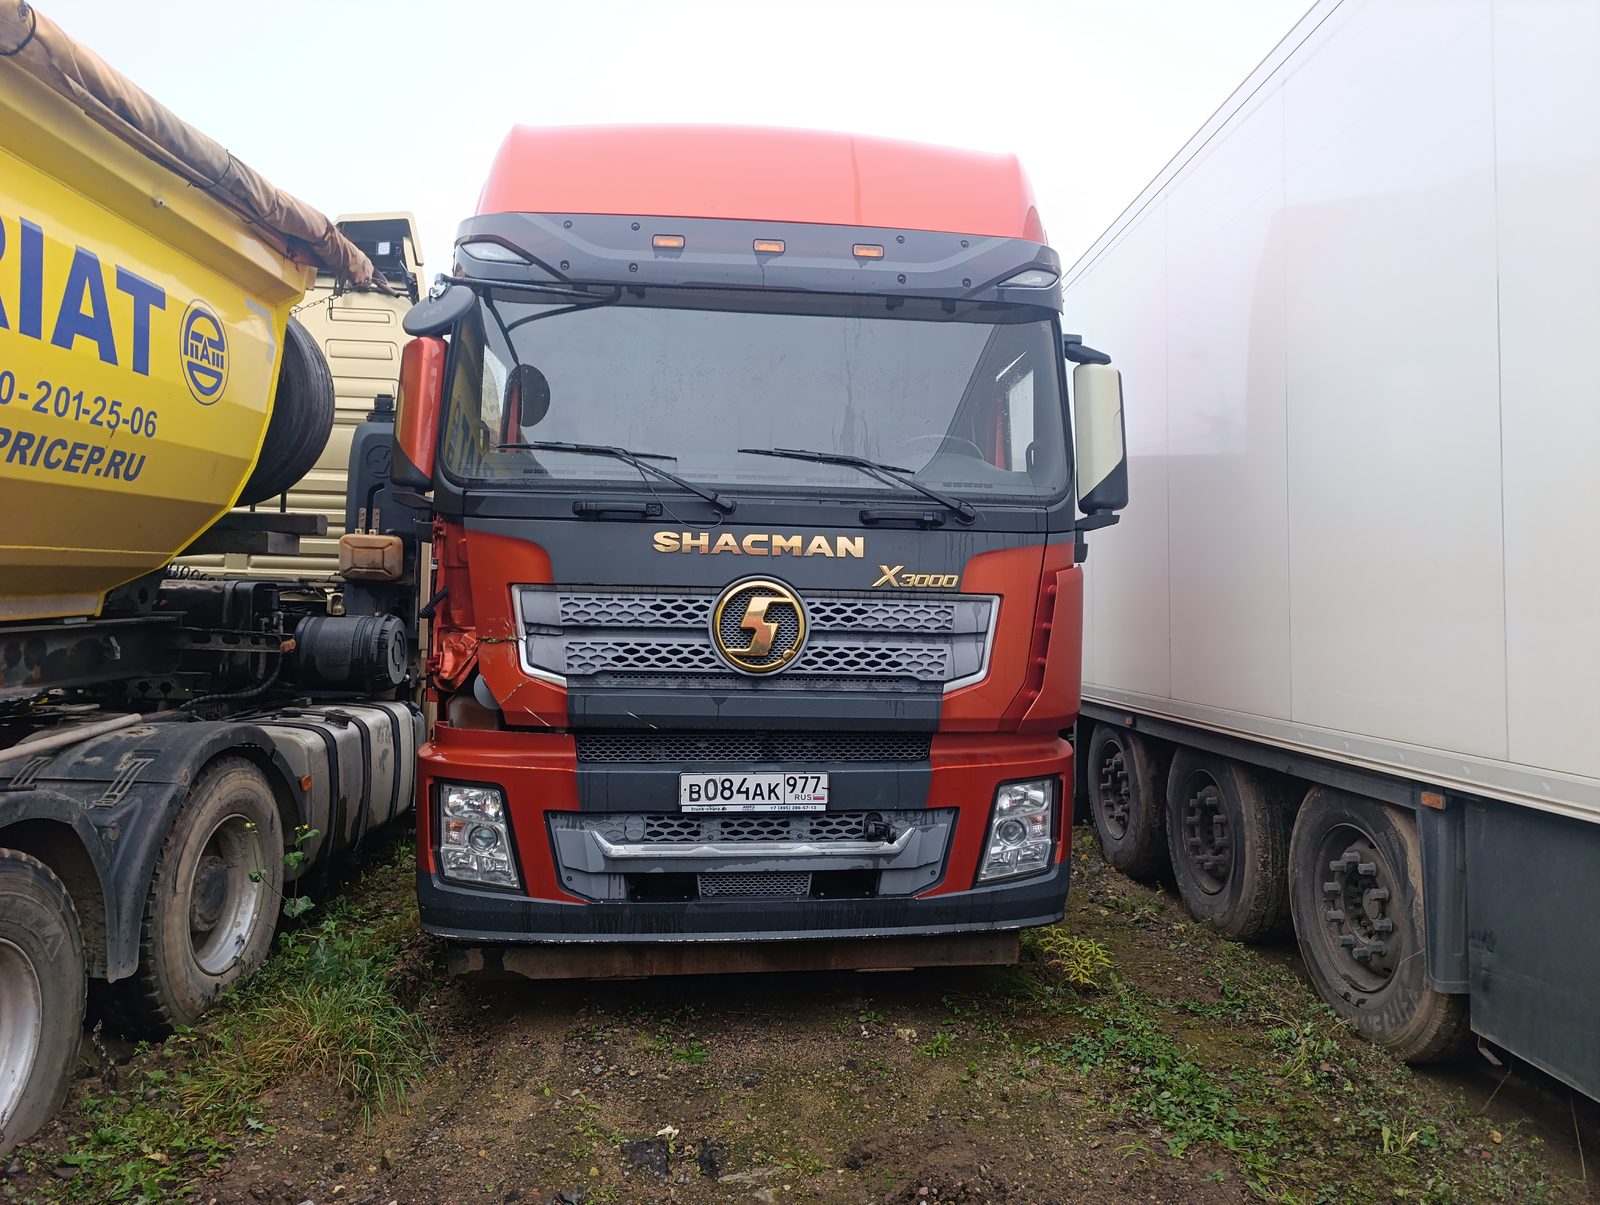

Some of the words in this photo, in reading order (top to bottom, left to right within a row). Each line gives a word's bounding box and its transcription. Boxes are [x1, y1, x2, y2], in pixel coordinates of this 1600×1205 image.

[0, 215, 166, 377] IAT
[653, 531, 865, 558] SHACMAN
[872, 564, 959, 589] X3000
[786, 775, 822, 794] 977
